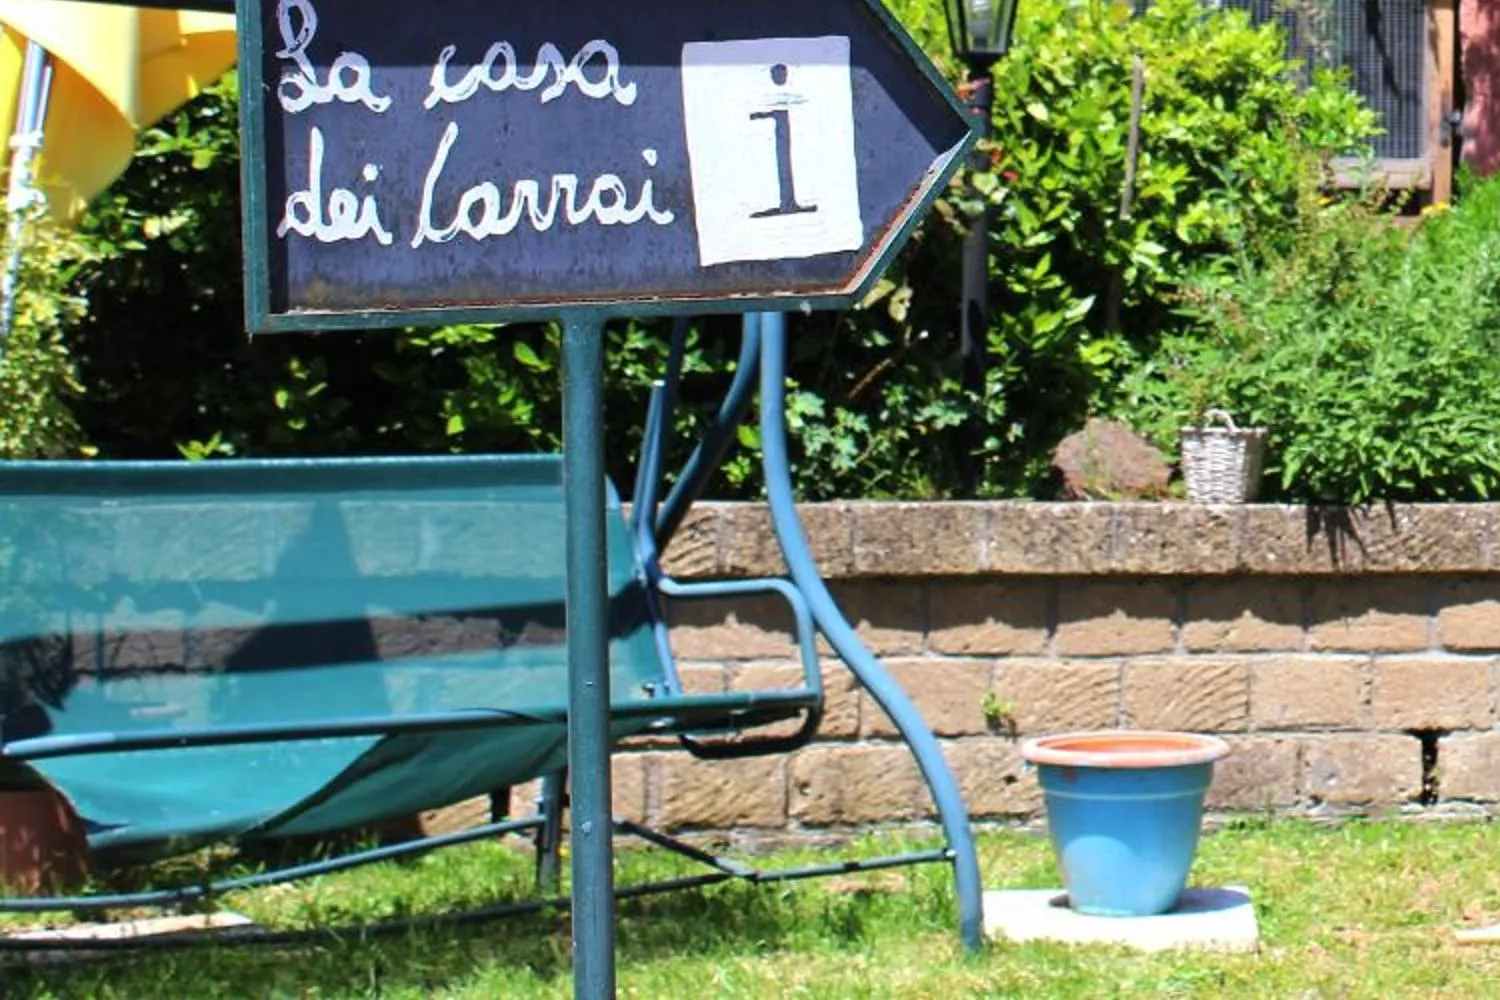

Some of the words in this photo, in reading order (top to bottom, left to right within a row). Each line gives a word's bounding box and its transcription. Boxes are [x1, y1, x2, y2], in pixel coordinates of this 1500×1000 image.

[423, 39, 637, 109] casa
[275, 126, 393, 245] dei
[749, 62, 818, 218] i
